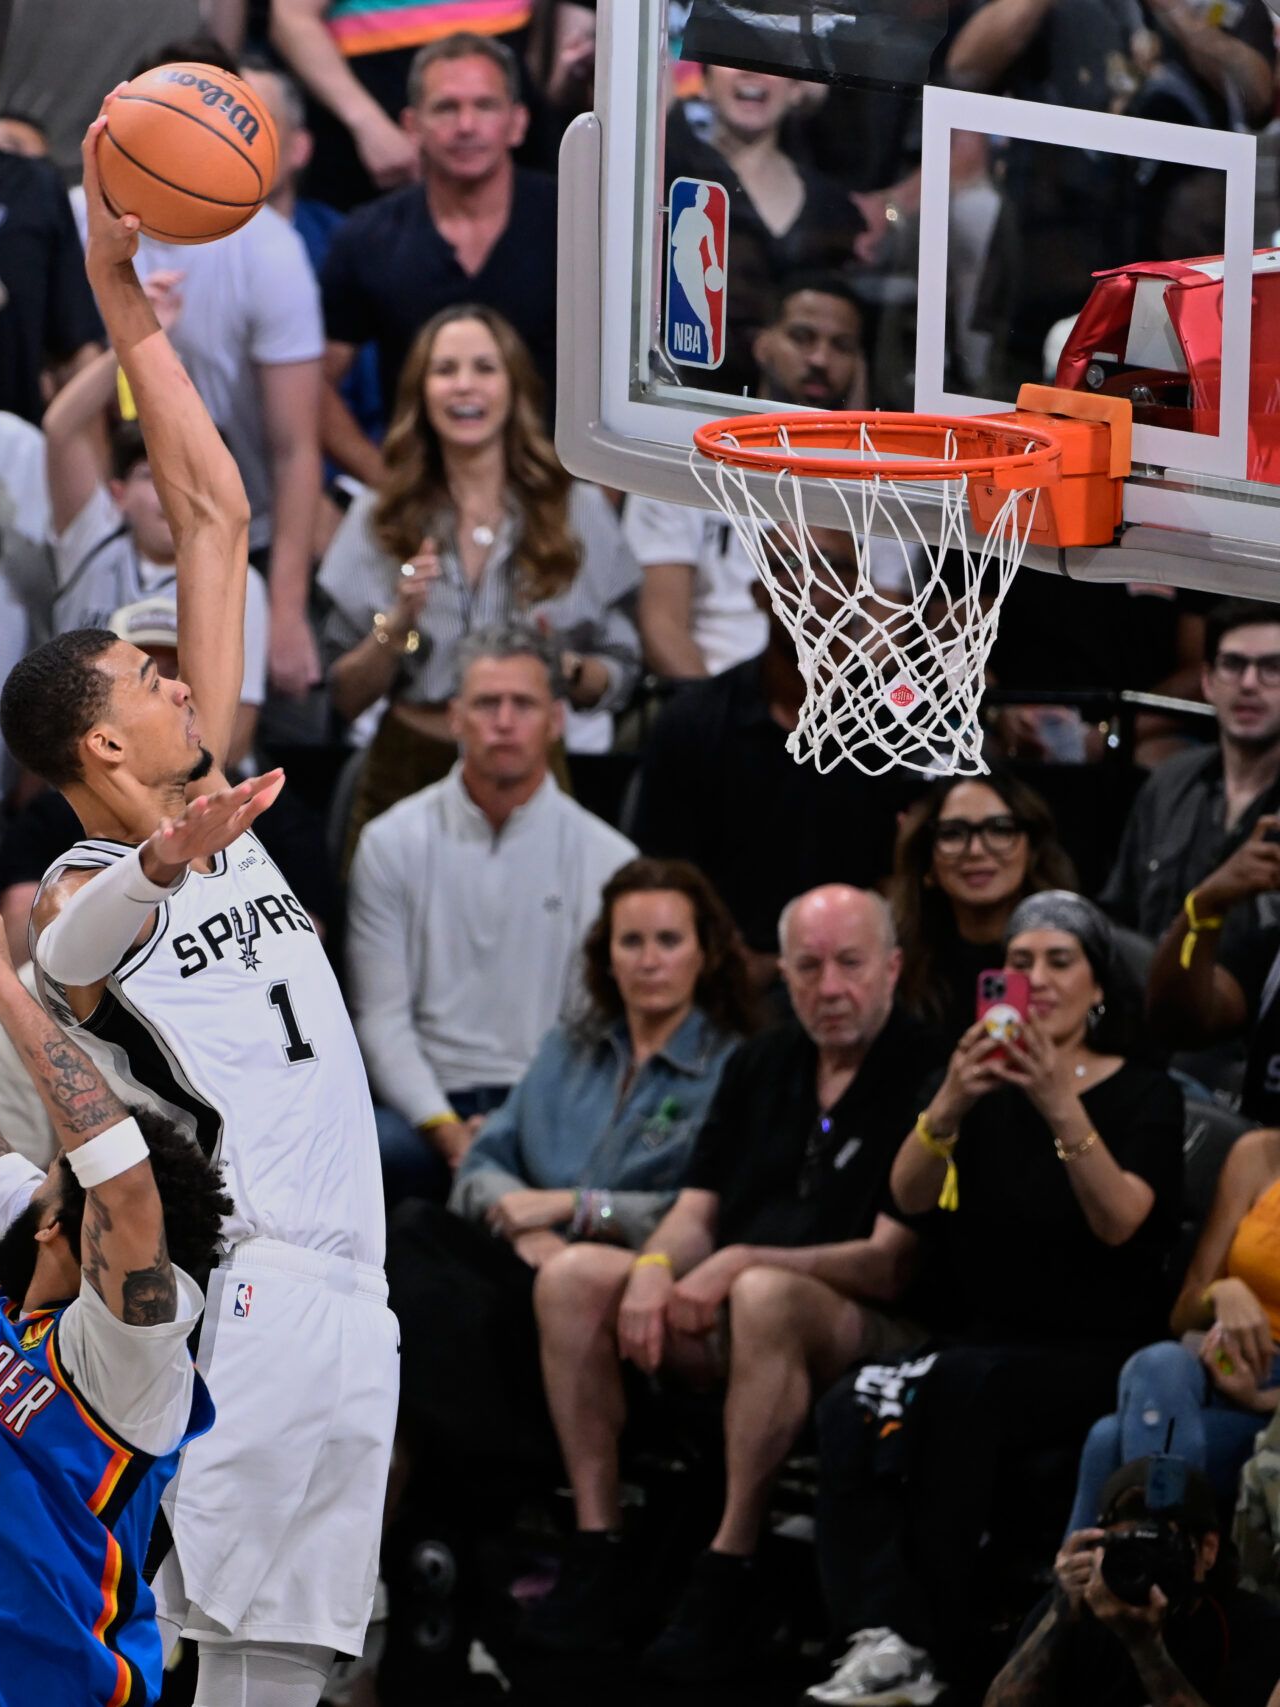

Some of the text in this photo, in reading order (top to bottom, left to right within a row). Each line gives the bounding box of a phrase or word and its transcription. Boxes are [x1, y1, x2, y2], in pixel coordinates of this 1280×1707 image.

[160, 70, 260, 147] Wilson
[673, 321, 702, 355] NBA
[172, 893, 316, 979] SPURS
[266, 979, 319, 1066] 1
